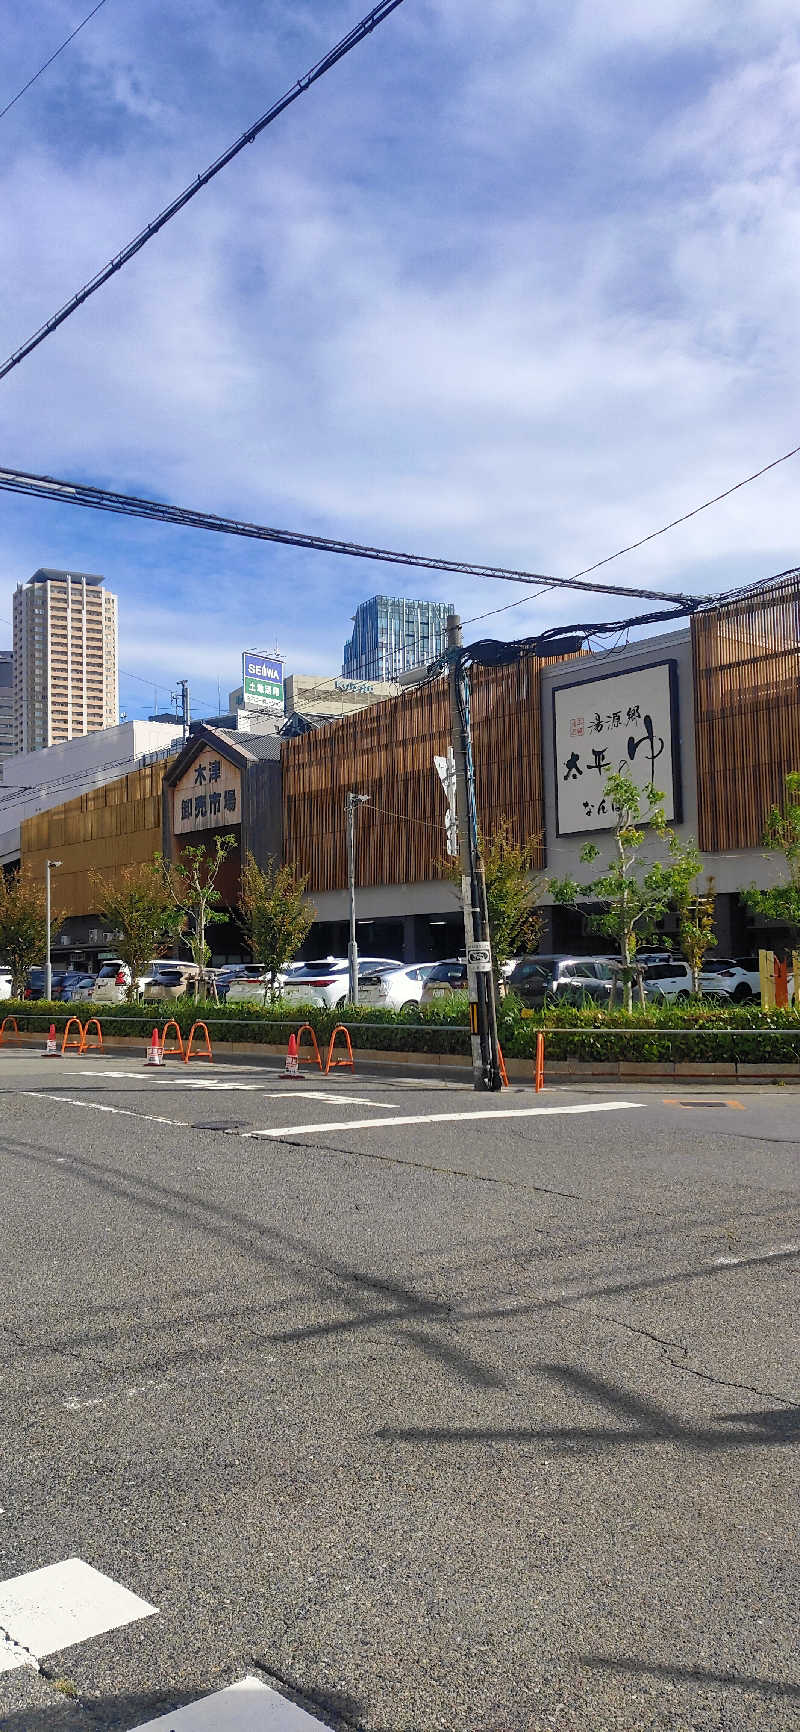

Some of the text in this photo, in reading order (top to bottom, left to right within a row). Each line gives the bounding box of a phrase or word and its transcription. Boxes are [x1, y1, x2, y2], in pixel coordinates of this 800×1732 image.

[248, 663, 280, 680] SEIWA
[194, 760, 222, 786] 木津
[181, 788, 237, 820] 卸売市場
